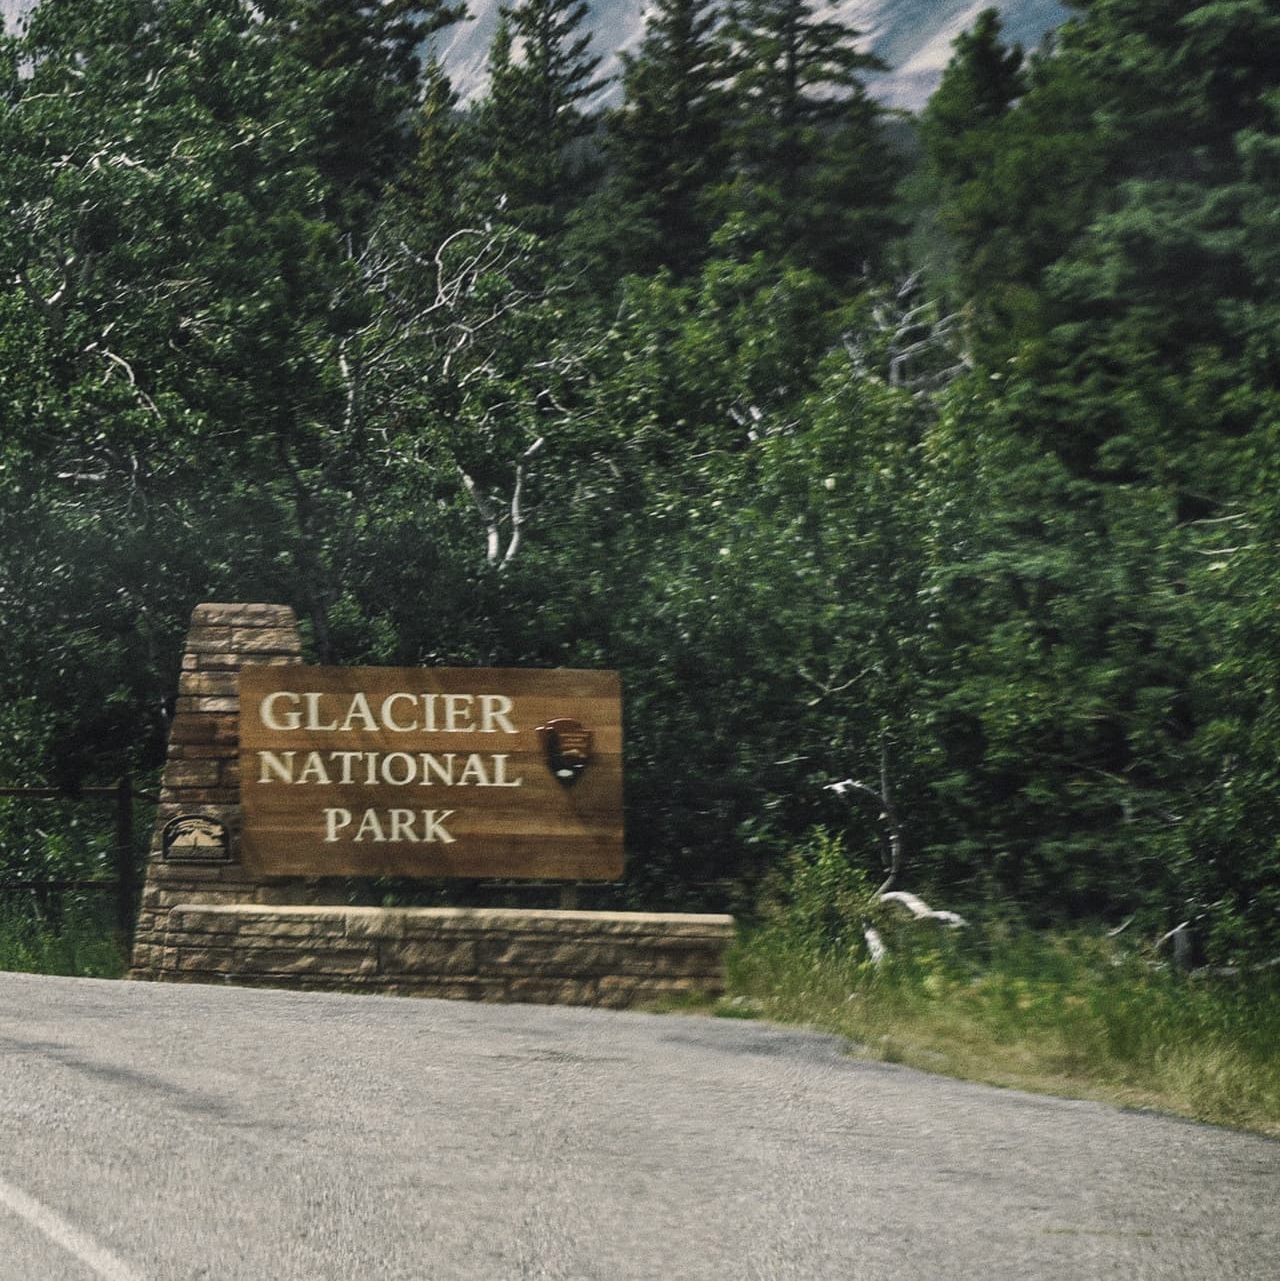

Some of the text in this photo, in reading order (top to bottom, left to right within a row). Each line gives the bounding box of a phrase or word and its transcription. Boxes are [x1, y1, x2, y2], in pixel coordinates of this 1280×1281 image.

[259, 691, 521, 734] GLACIER
[256, 750, 524, 787] NATIONAL
[322, 807, 458, 844] PARK
